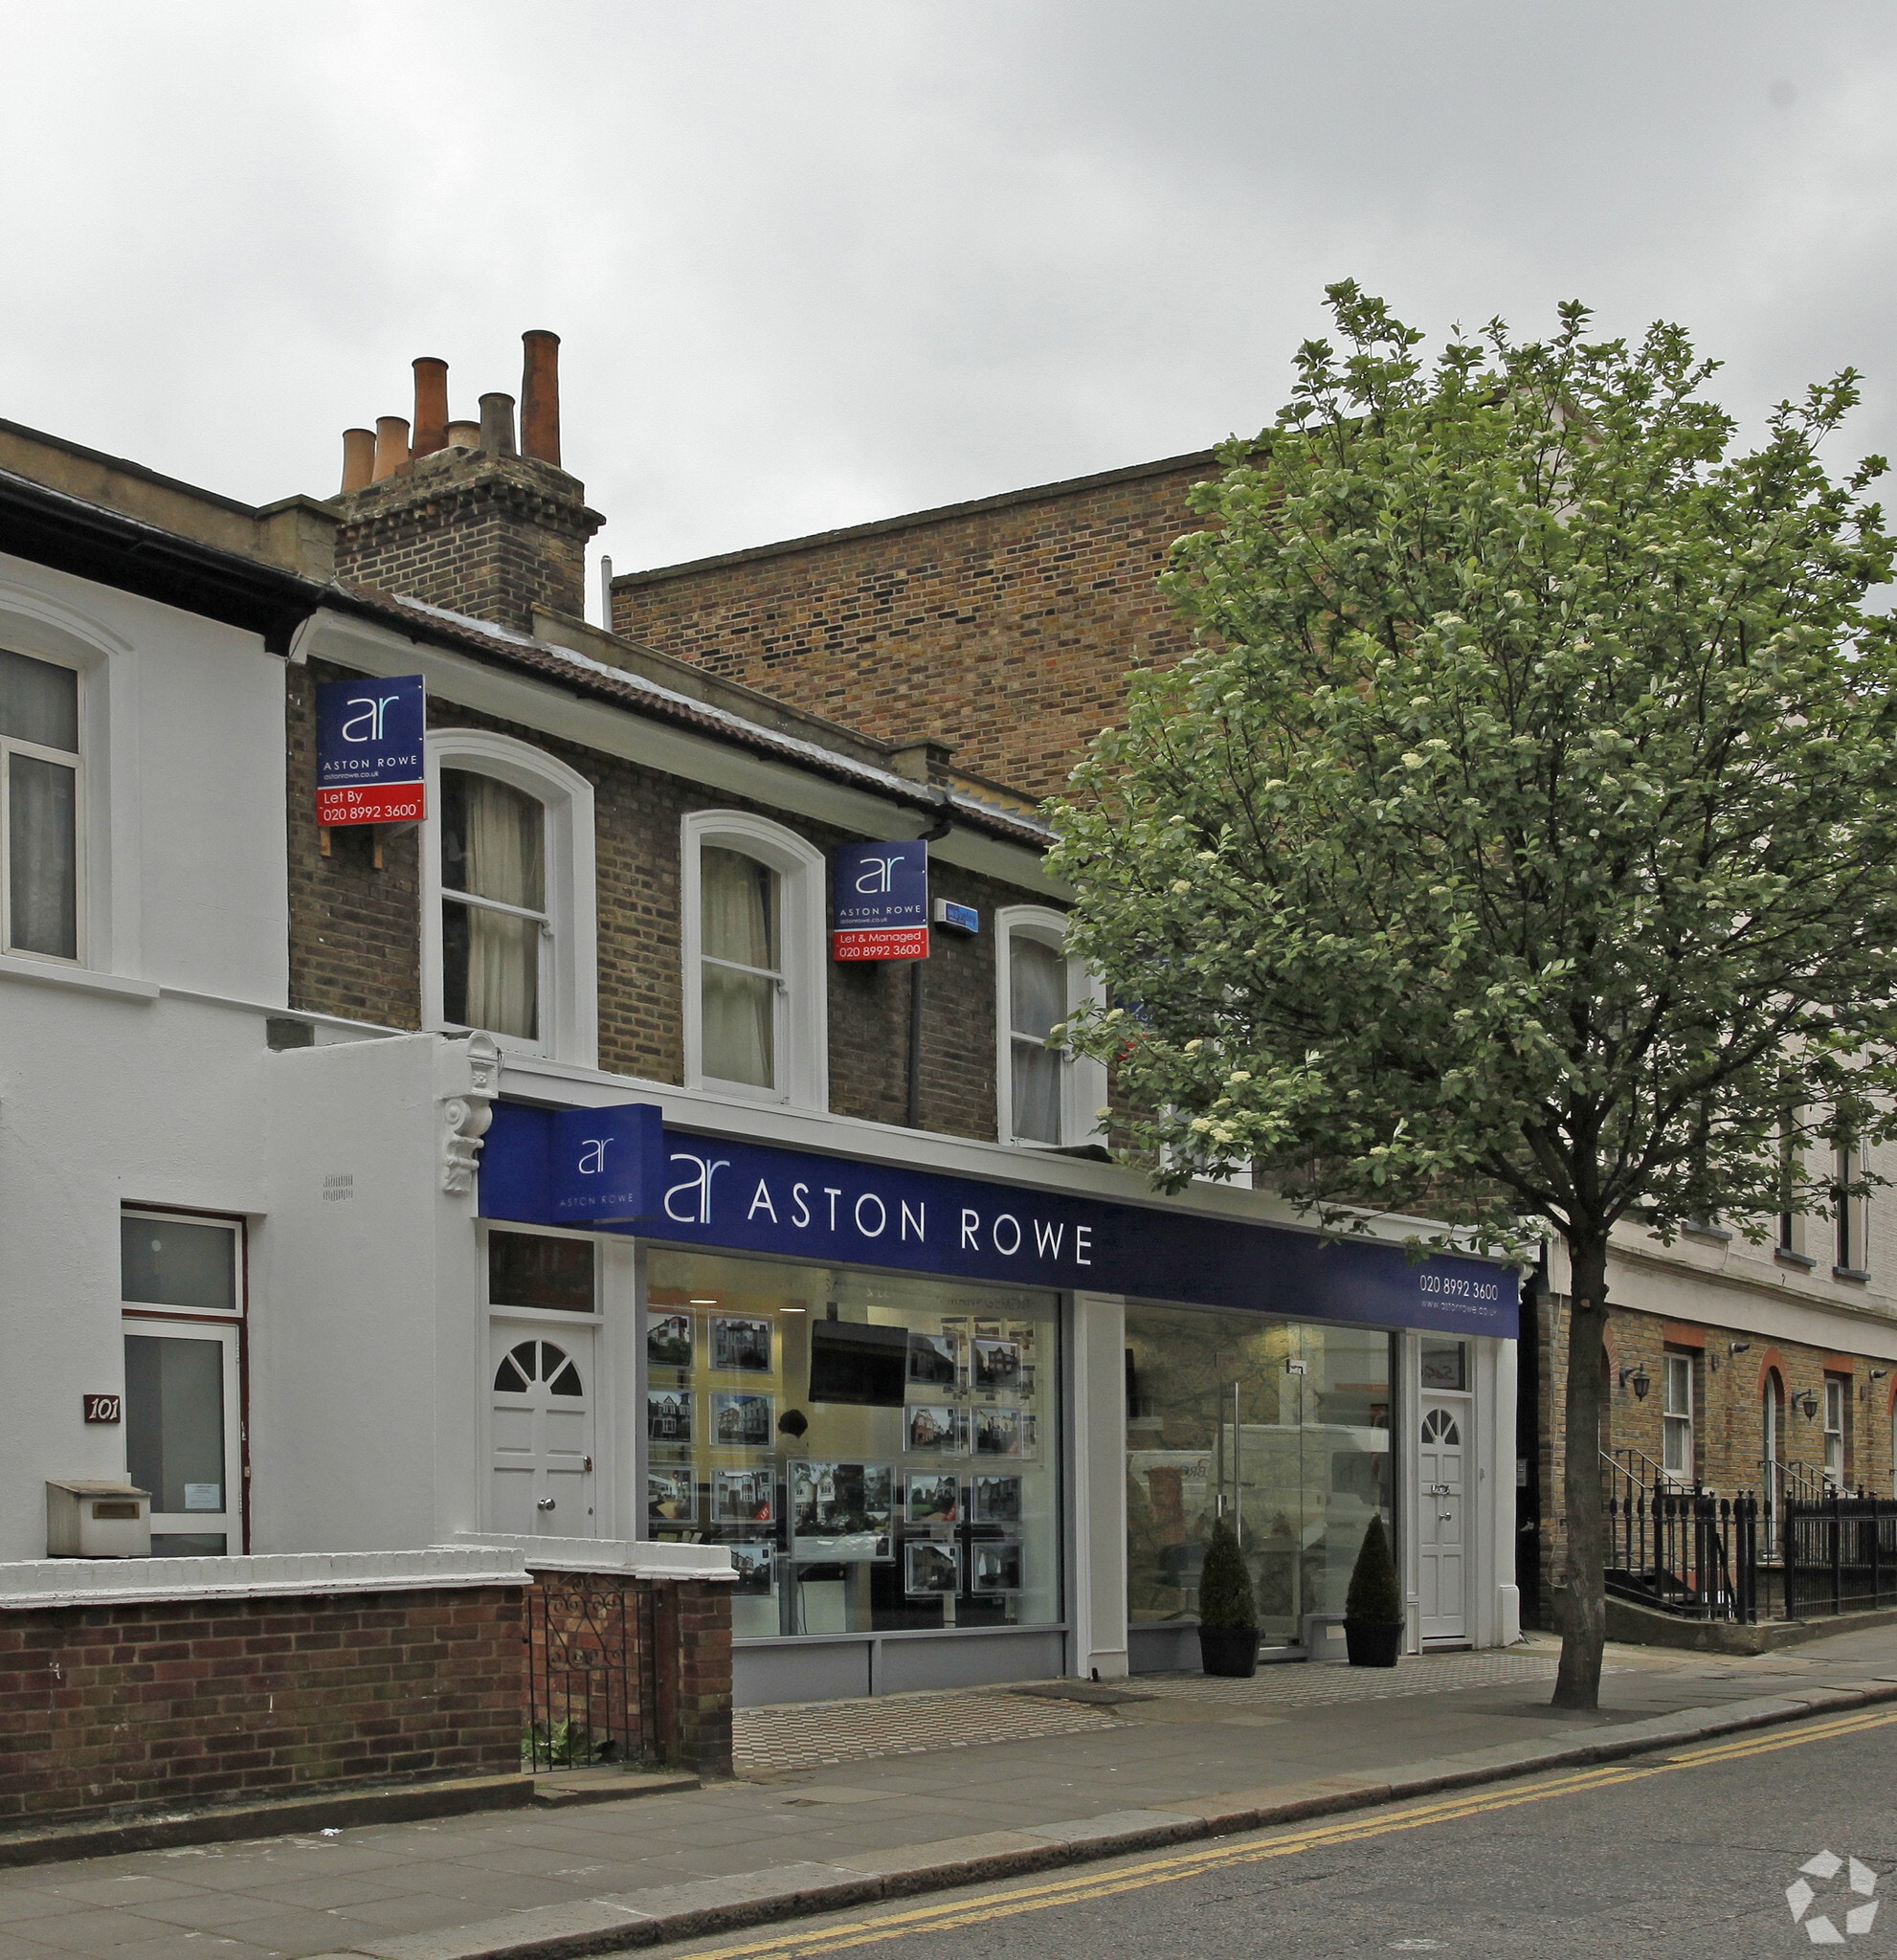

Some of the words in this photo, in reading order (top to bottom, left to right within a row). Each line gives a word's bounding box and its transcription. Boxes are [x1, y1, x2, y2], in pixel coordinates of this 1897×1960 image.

[342, 696, 400, 742] ar
[323, 760, 369, 770] ASTON
[377, 755, 417, 767] ROWE
[324, 770, 379, 780] astonrowe.co.uk
[324, 792, 344, 804] Let
[347, 791, 363, 805] By
[324, 808, 346, 821] 020
[350, 806, 381, 819] 8992
[385, 803, 416, 816] 3600
[856, 857, 905, 894] ar
[839, 907, 880, 917] ASTON
[886, 904, 921, 915] ROWE
[840, 934, 856, 944] Let
[859, 933, 866, 943] &
[869, 931, 922, 944] Managed
[839, 947, 860, 958] 020
[862, 945, 890, 956] 8992
[893, 944, 921, 955] 3600
[578, 1137, 614, 1174] ar
[663, 1153, 730, 1224] ar
[560, 1196, 595, 1207] ASTON
[601, 1192, 634, 1204] ROWE
[747, 1177, 926, 1242] ASTON
[961, 1208, 1092, 1265] ROWE
[1419, 1275, 1440, 1293] 020
[1443, 1278, 1470, 1297] 8992
[1473, 1282, 1499, 1301] 3600
[1421, 1300, 1497, 1317] www.astonrowe.co.uk
[89, 1397, 120, 1420] 101
